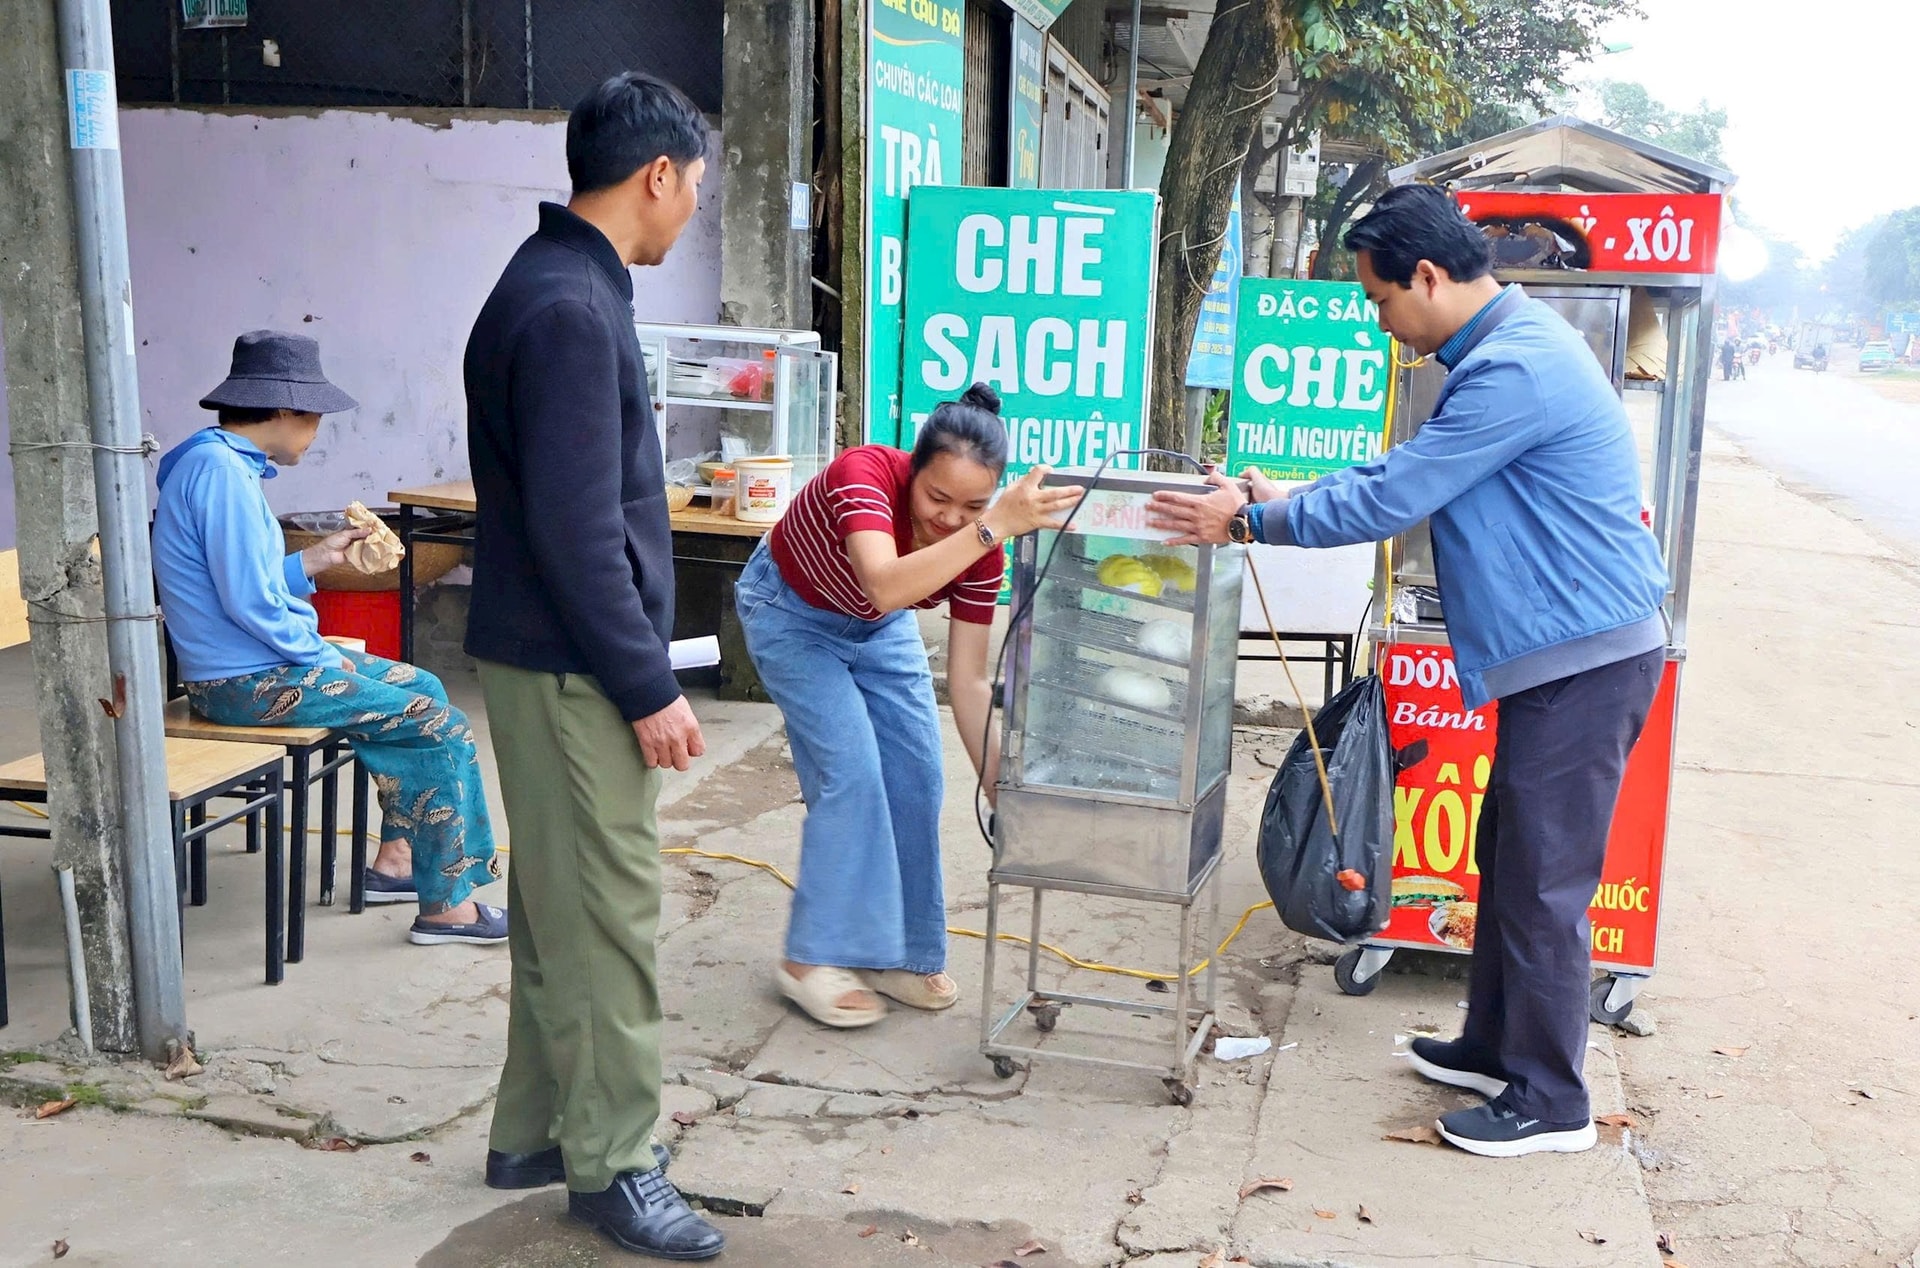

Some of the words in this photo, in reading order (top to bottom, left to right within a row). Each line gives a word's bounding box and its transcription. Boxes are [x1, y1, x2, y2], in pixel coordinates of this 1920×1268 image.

[942, 8, 960, 37] ĐÁ
[875, 59, 915, 98] CHUYÊN
[917, 71, 939, 106] CÁC
[941, 83, 961, 120] LOẠI
[881, 122, 943, 199] TRÀ
[1624, 205, 1694, 262] XÔI
[1258, 290, 1319, 324] ĐẶC
[1327, 292, 1380, 323] SẢN
[1243, 331, 1385, 412] CHÈ
[998, 410, 1131, 469] NGUYÊN
[1236, 417, 1284, 456] THÁI
[1291, 420, 1384, 462] NGUYÊN
[1262, 465, 1305, 480] Nguyễn
[1392, 701, 1486, 731] Bánh
